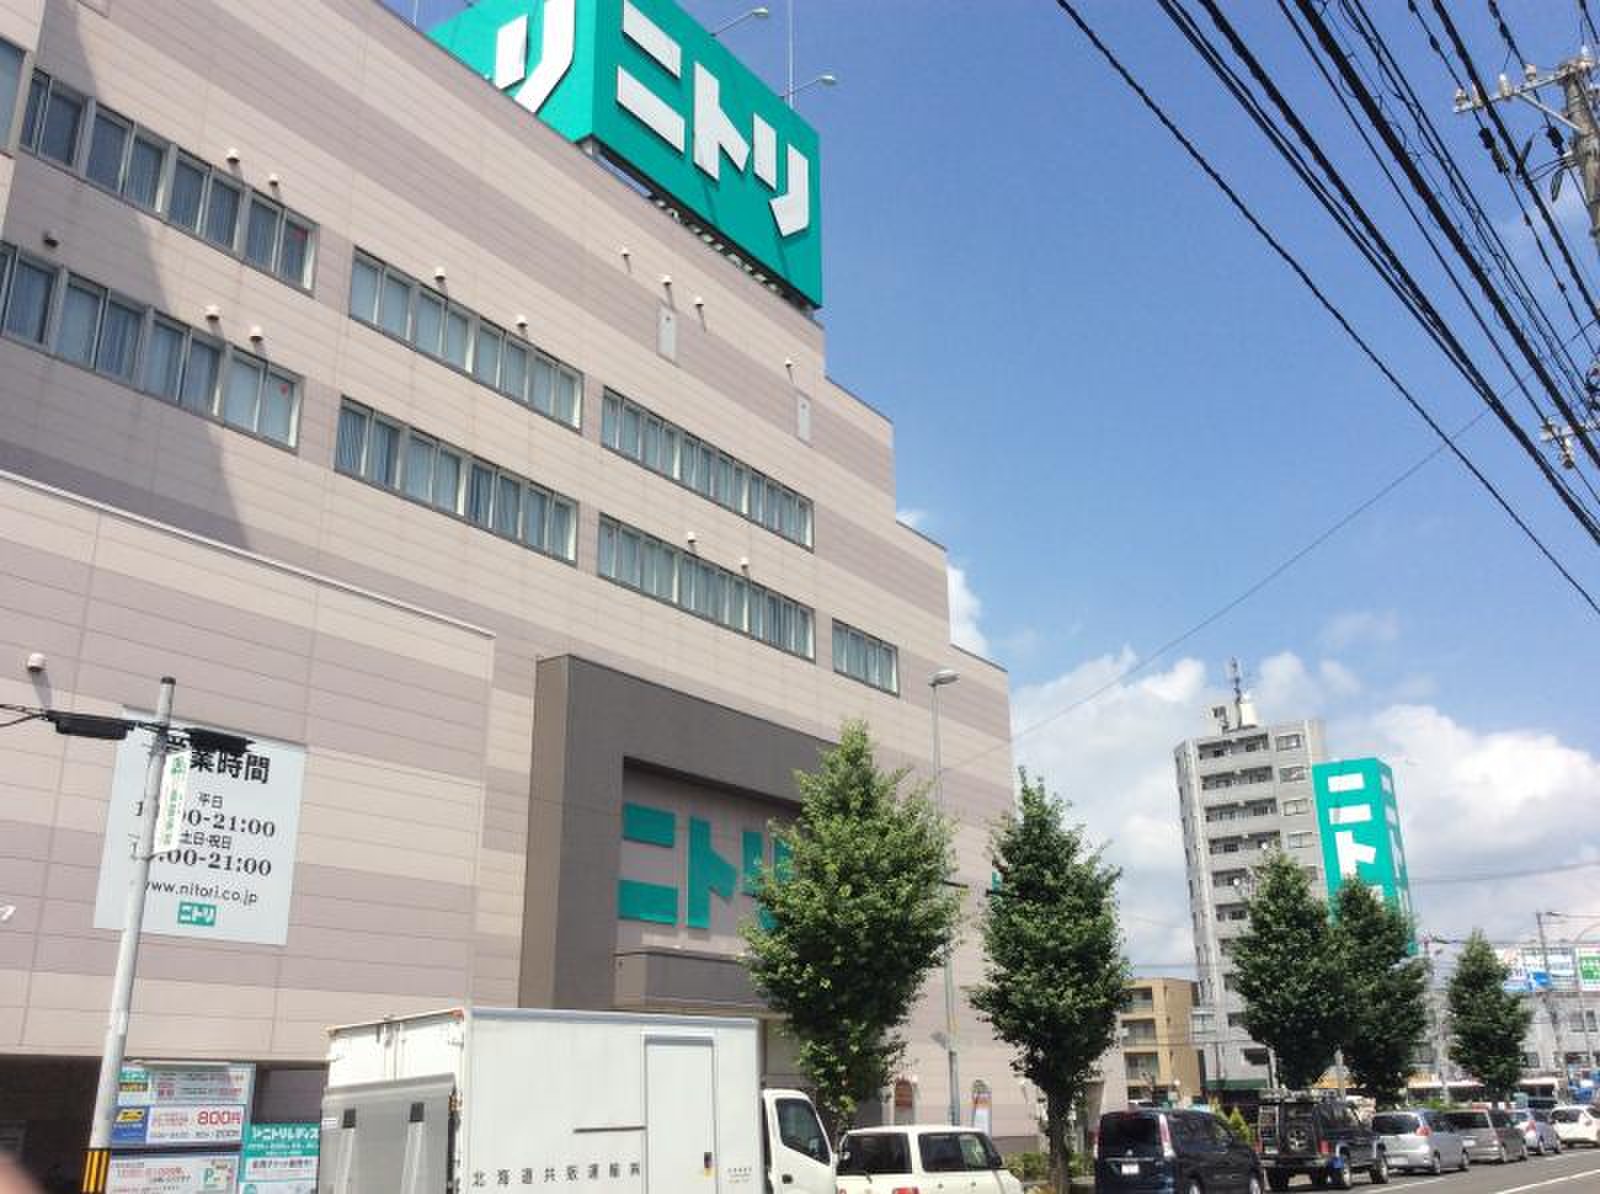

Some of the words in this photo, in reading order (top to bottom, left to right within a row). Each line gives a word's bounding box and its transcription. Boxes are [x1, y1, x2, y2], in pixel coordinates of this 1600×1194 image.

[617, 0, 809, 237] ニトリ
[198, 792, 223, 809] 平日
[1327, 772, 1383, 901] ニト
